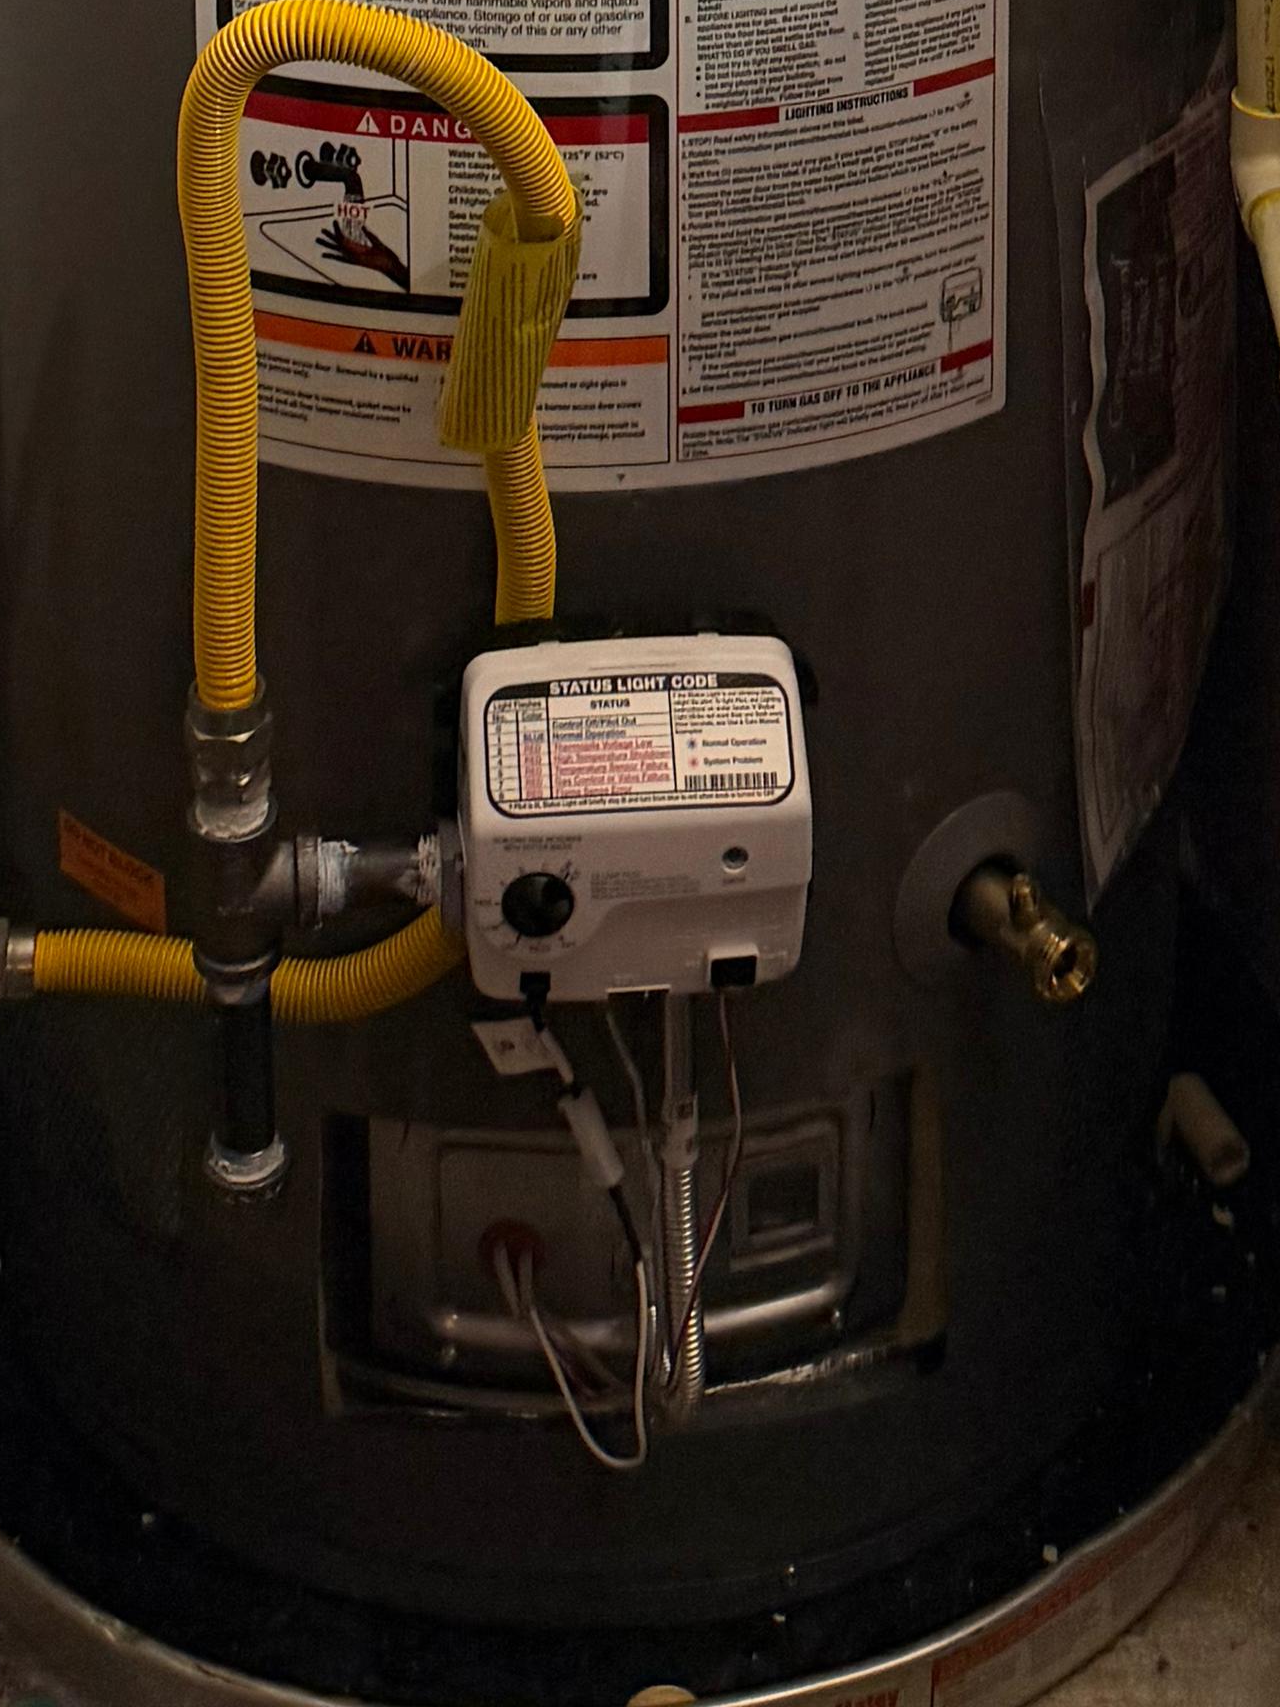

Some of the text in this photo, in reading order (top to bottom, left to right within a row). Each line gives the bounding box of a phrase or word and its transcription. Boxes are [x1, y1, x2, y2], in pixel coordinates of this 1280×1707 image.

[411, 7, 644, 24] appliance. Storage of or use of gasoline
[446, 22, 622, 38] the vicinity of this or any other
[784, 87, 909, 121] LIGHTING INSTRUCTIONS
[390, 117, 472, 141] DANG
[448, 148, 475, 159] Water
[594, 150, 625, 161] (52°C)
[448, 161, 466, 169] can
[448, 185, 492, 197] Children,
[335, 202, 370, 220] HOT
[750, 363, 937, 416] TO TURN GAS OFF TO THE APPLIANCE
[549, 674, 718, 695] STATUS LIGHT CODE
[590, 698, 631, 710] STATUS
[702, 737, 767, 747] Normal Operation
[703, 757, 763, 766] System Problem
